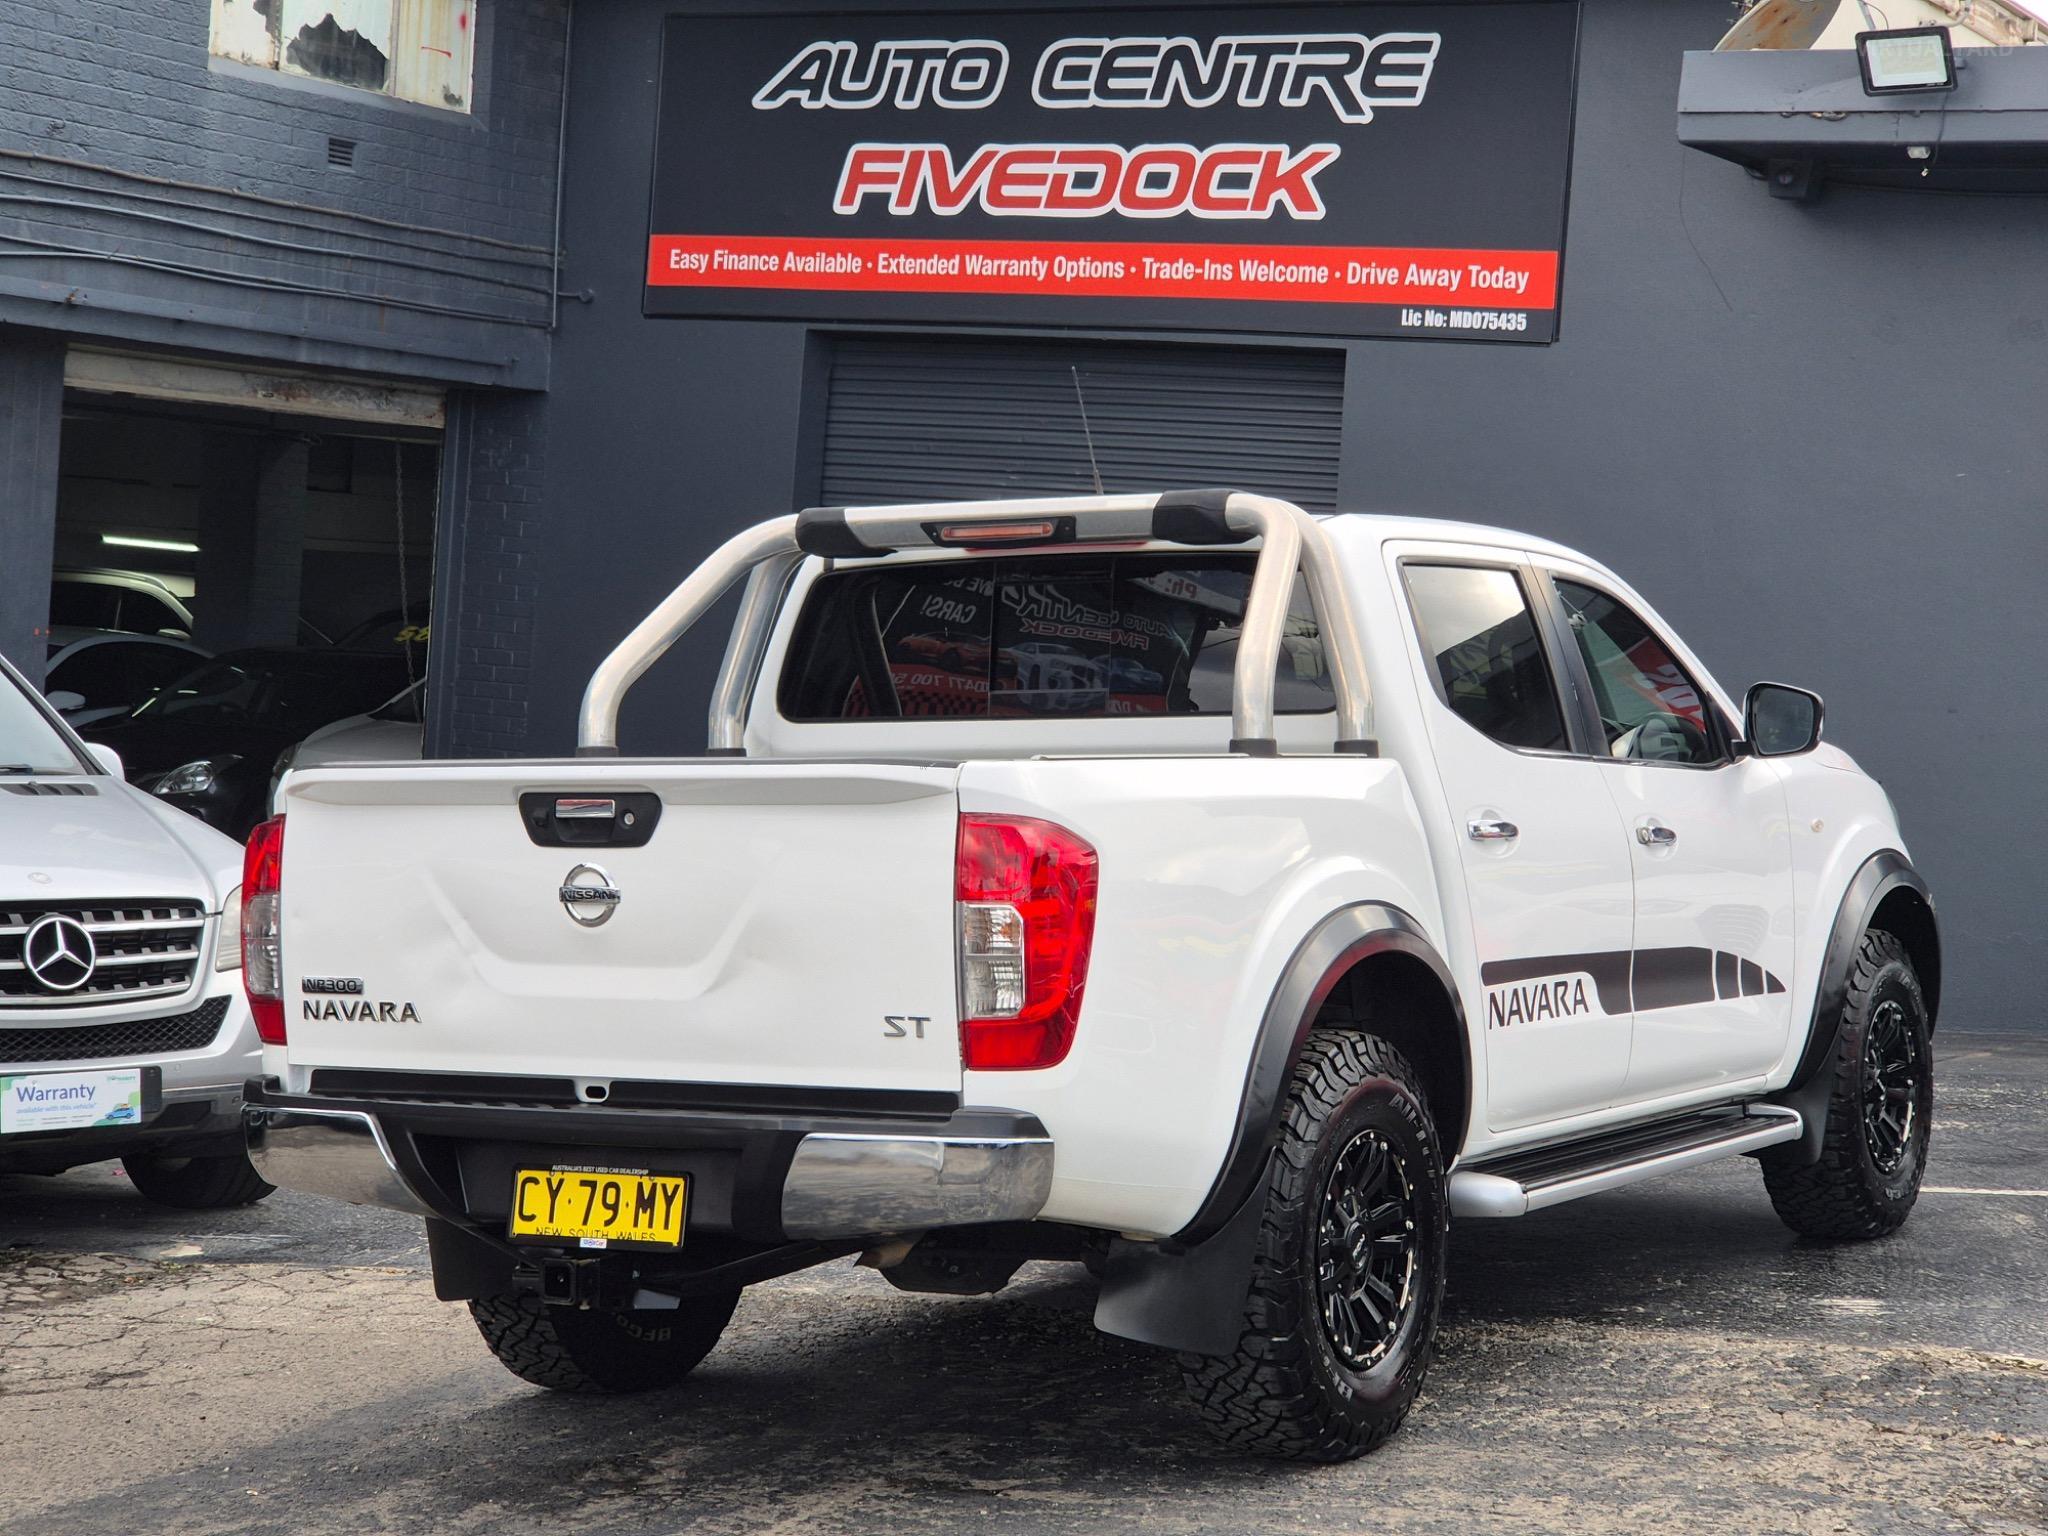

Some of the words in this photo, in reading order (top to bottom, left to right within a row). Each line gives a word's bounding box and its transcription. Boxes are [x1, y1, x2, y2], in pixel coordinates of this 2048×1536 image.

[751, 39, 1010, 110] AUTO
[1031, 32, 1441, 124] CENTRE
[833, 143, 1341, 220] FIVEDOCK
[670, 249, 709, 273] Easy
[713, 250, 779, 272] Finance
[783, 251, 862, 273] Available
[877, 253, 959, 275] Extended
[965, 254, 1049, 281] Warranty
[1053, 255, 1125, 282] Options
[1142, 257, 1233, 281] Trade-Ins
[1239, 259, 1328, 283] Welcome
[1347, 262, 1399, 285] Drive
[1404, 263, 1462, 292] Away
[1468, 265, 1530, 295] Today
[1401, 309, 1422, 327] Lic
[1424, 309, 1447, 328] No:
[1449, 310, 1527, 331] MD075435
[563, 889, 612, 901] NISSAN
[305, 978, 358, 992] NP300
[303, 1000, 422, 1023] NAVARA
[1489, 978, 1589, 1030] NAVARA
[884, 1016, 931, 1038] ST
[17, 1084, 96, 1102] Warranty
[536, 1226, 561, 1236] NEW
[569, 1228, 609, 1239] SOUTH
[616, 1231, 656, 1241] WALES
